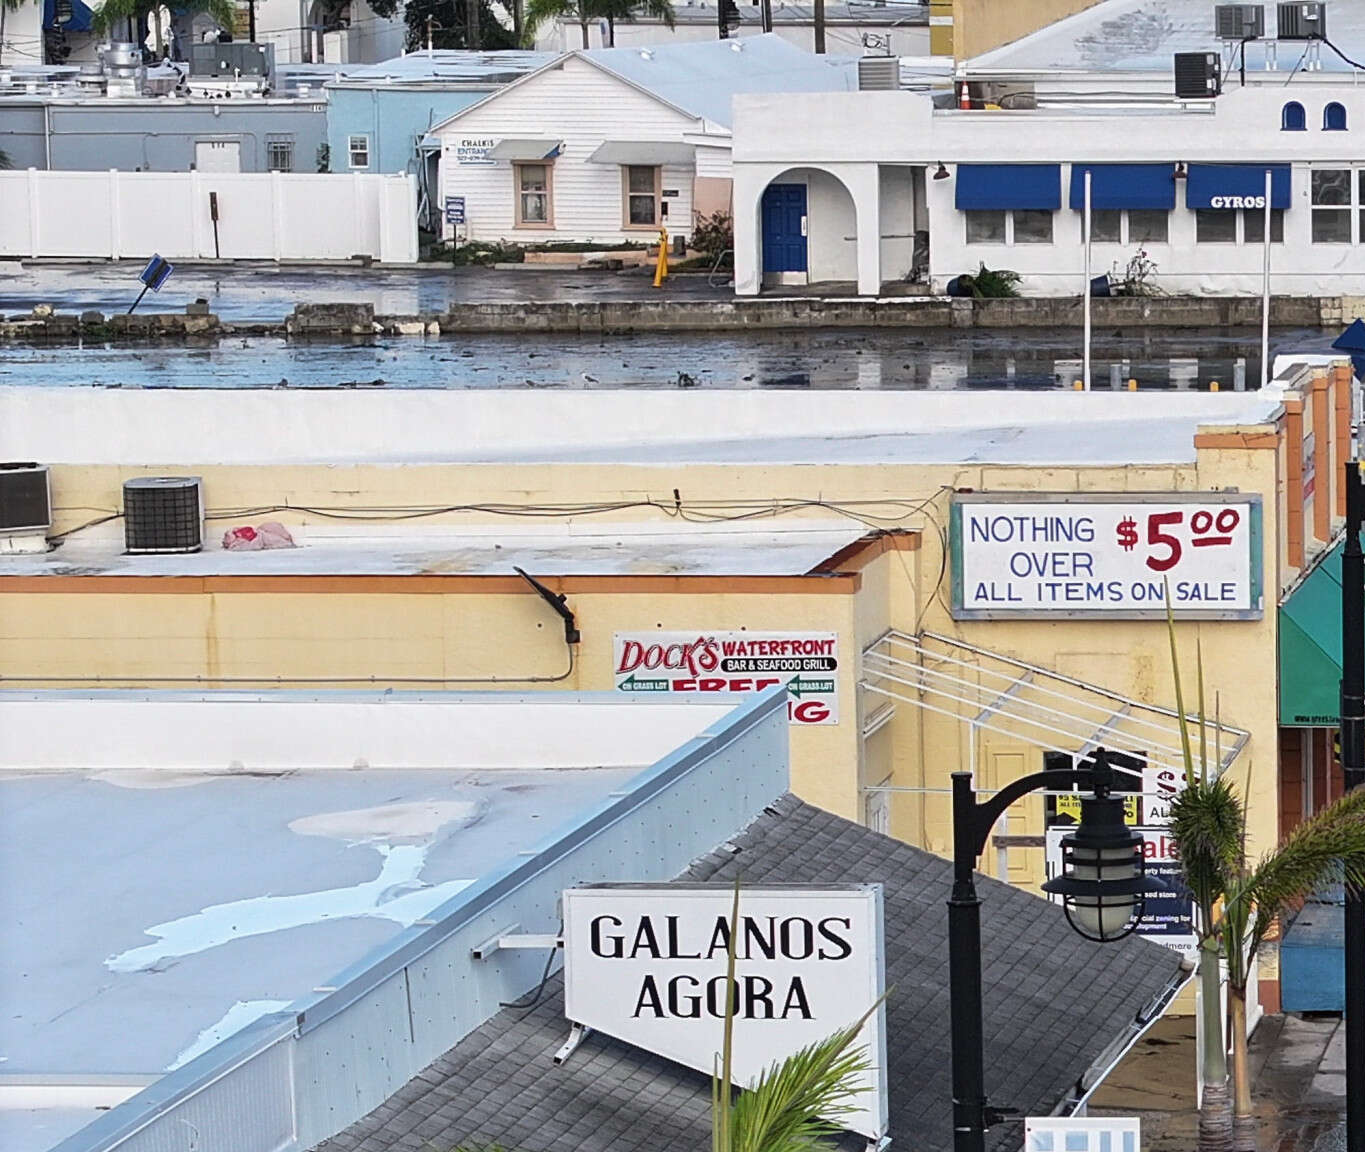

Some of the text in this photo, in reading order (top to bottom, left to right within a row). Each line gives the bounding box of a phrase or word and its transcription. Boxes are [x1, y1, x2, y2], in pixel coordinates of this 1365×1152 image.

[1210, 195, 1266, 209] GYROS
[971, 516, 1095, 543] NOTHING
[1010, 552, 1094, 578] OVER
[974, 582, 1237, 601] ALL ITEMS ON SALE
[615, 636, 720, 679] DOCK'S
[721, 639, 835, 657] WATERFRONT
[727, 658, 831, 672] BAR & SEAFOOD GRILL
[655, 682, 668, 690] LOT
[1134, 835, 1180, 860] ale
[590, 915, 853, 961] GALANOS
[631, 974, 816, 1020] AGORA
